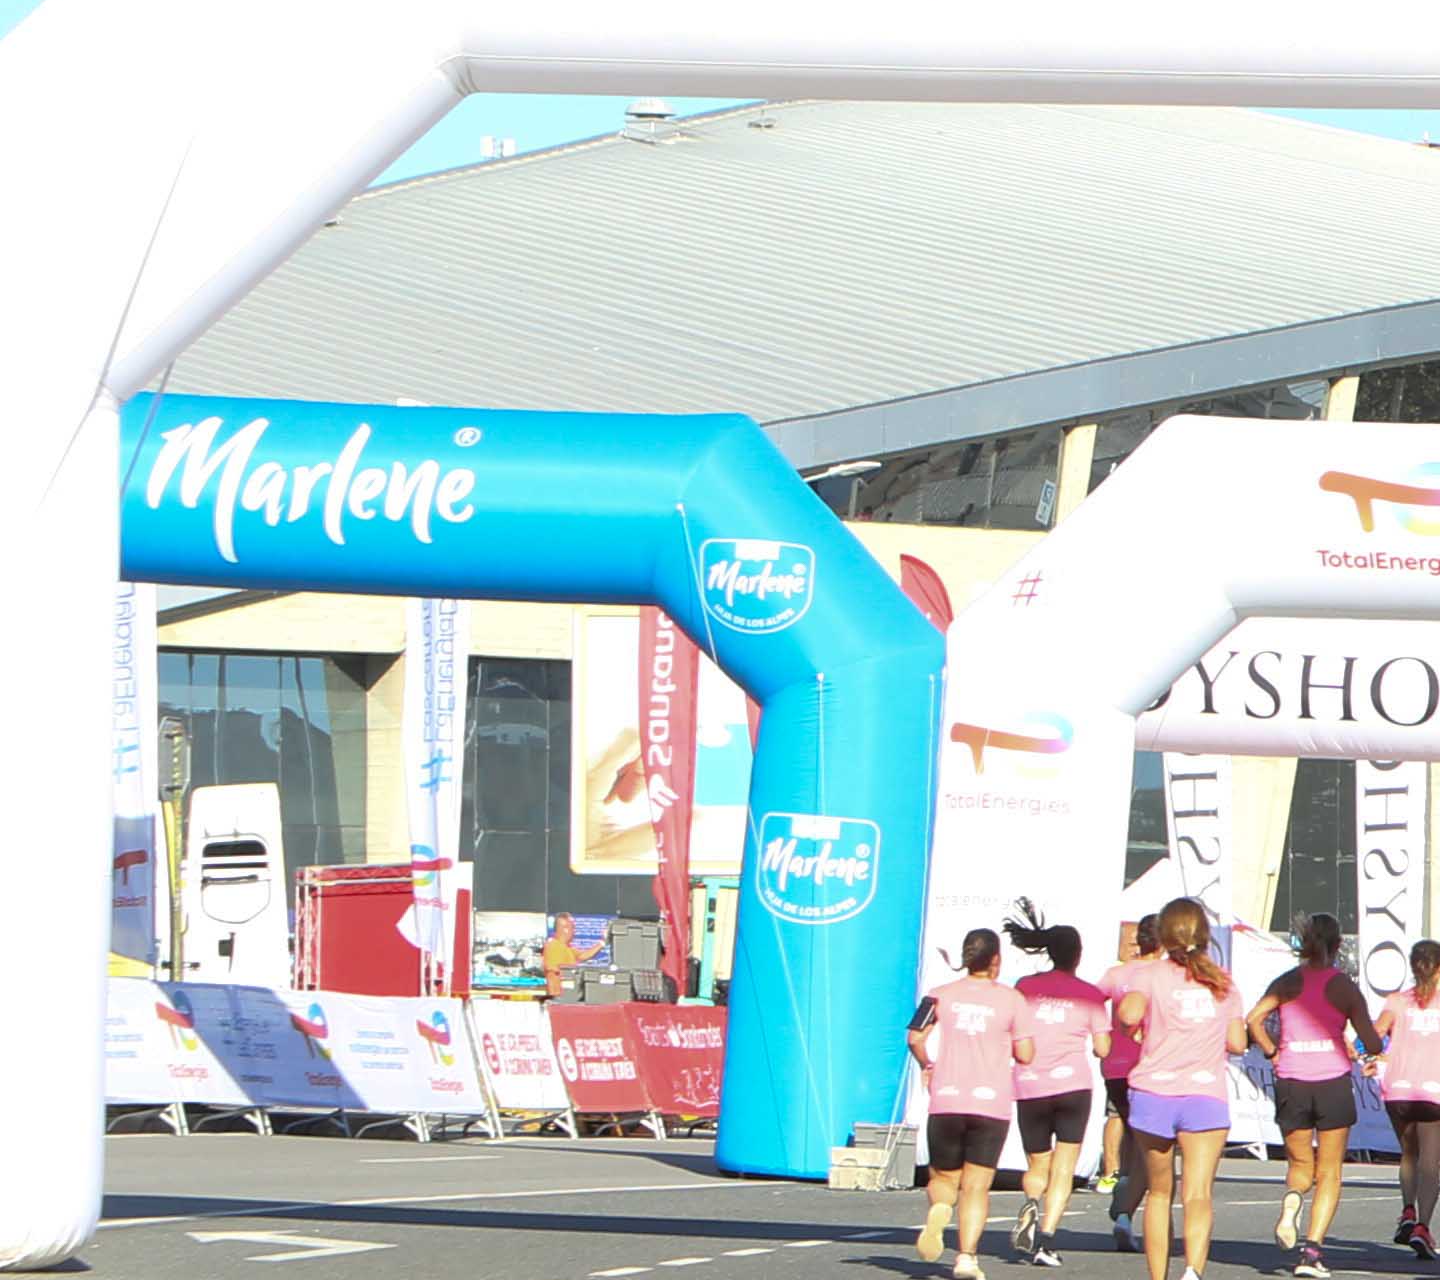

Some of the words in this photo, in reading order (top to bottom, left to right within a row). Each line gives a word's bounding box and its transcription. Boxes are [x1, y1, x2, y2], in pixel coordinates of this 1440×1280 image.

[145, 415, 475, 564] Marlene
[708, 559, 806, 607] Marlene
[944, 793, 1071, 815] TotalEnergies
[761, 836, 870, 891] Marlene
